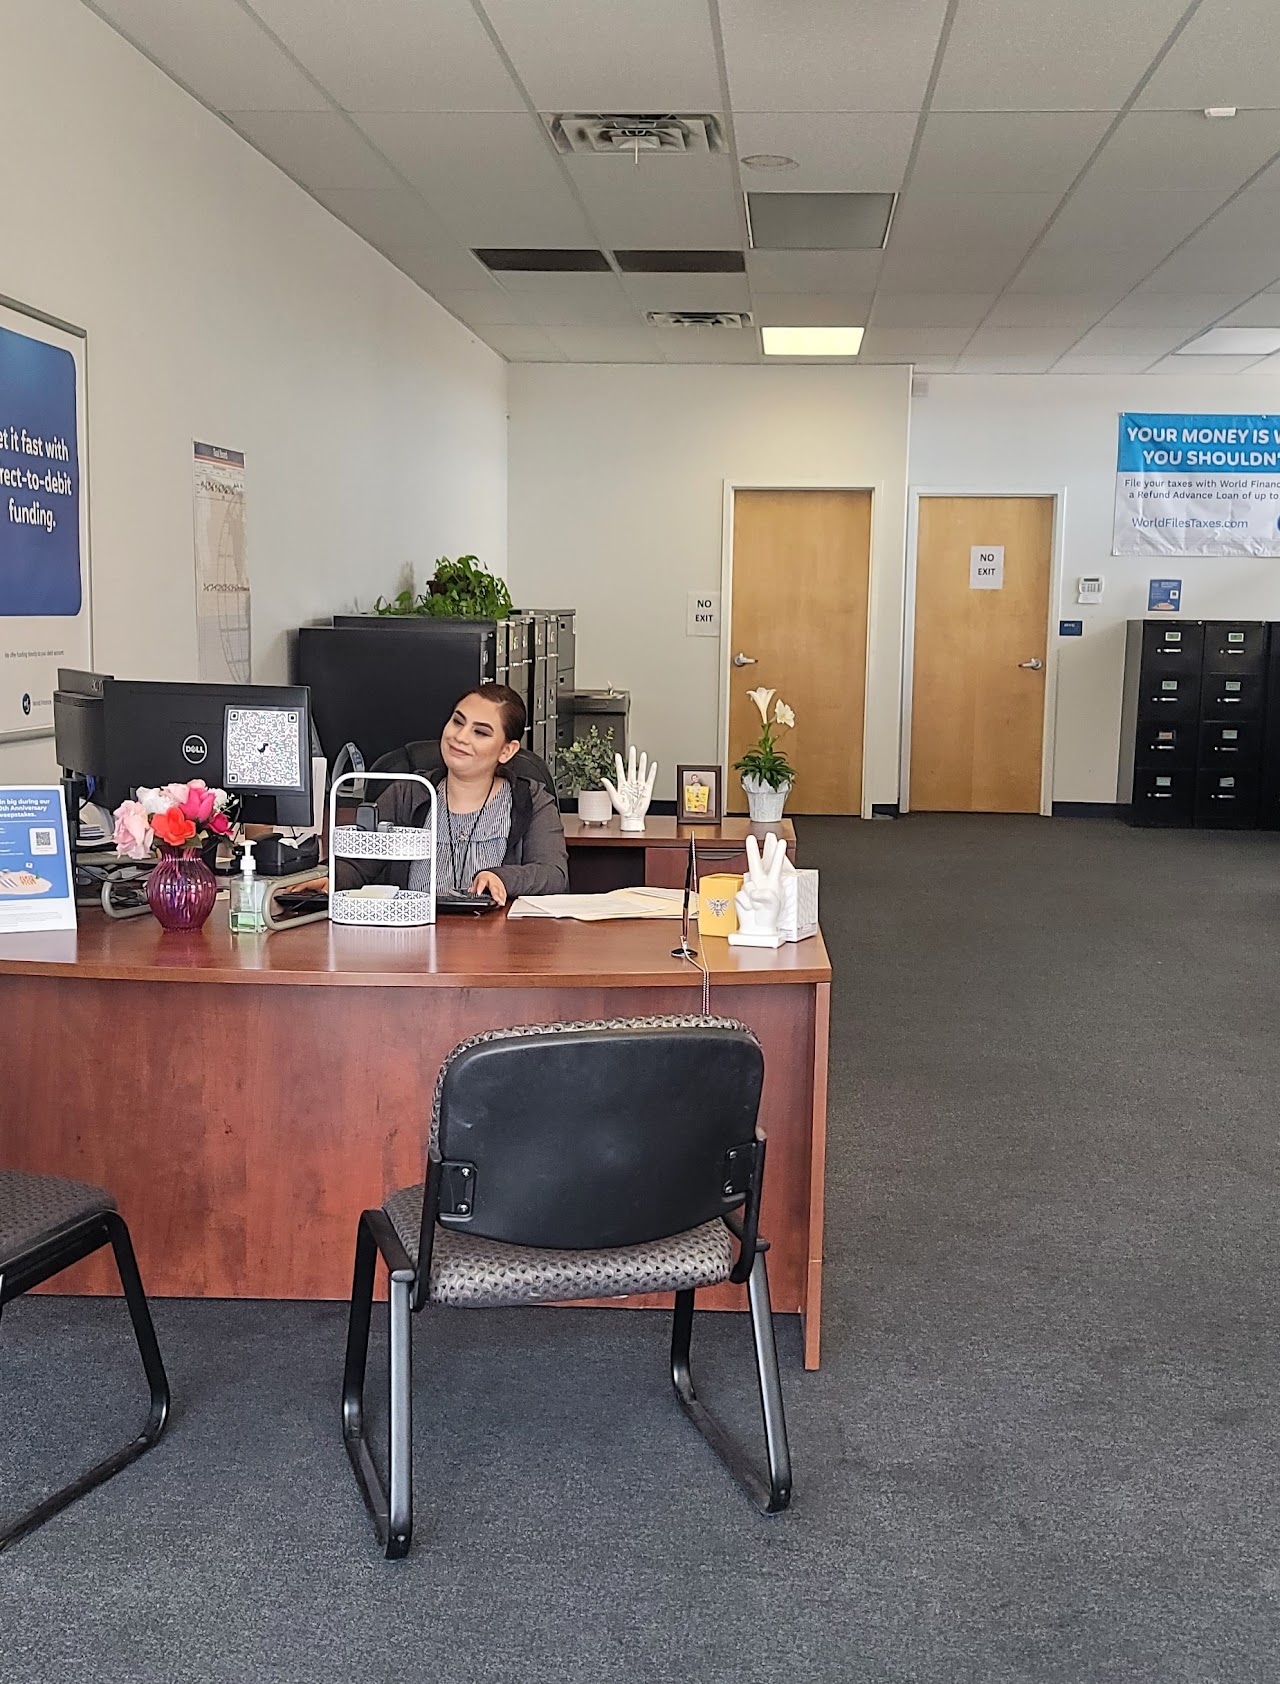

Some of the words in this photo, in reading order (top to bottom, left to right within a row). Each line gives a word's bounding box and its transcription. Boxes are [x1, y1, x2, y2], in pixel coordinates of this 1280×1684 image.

[1127, 427, 1178, 442] YOUR
[1182, 428, 1250, 444] MONEY
[1252, 429, 1270, 444] IS
[10, 426, 19, 452] it
[21, 429, 43, 456] fast
[45, 436, 68, 462] with
[1143, 450, 1182, 465] YOU
[1124, 479, 1142, 488] File
[1143, 480, 1165, 489] your
[1167, 480, 1193, 488] taxes
[1195, 479, 1217, 488] with
[1219, 480, 1248, 488] World
[1137, 490, 1170, 499] Refund
[1173, 490, 1213, 499] Advance
[1216, 491, 1239, 500] Loan
[1242, 491, 1252, 500] of
[1254, 493, 1267, 501] up
[1269, 492, 1279, 500] to
[9, 498, 56, 532] funding.
[1132, 518, 1248, 528] WorldFilesTaxes.com
[697, 600, 712, 608] NO
[186, 745, 204, 753] DELL
